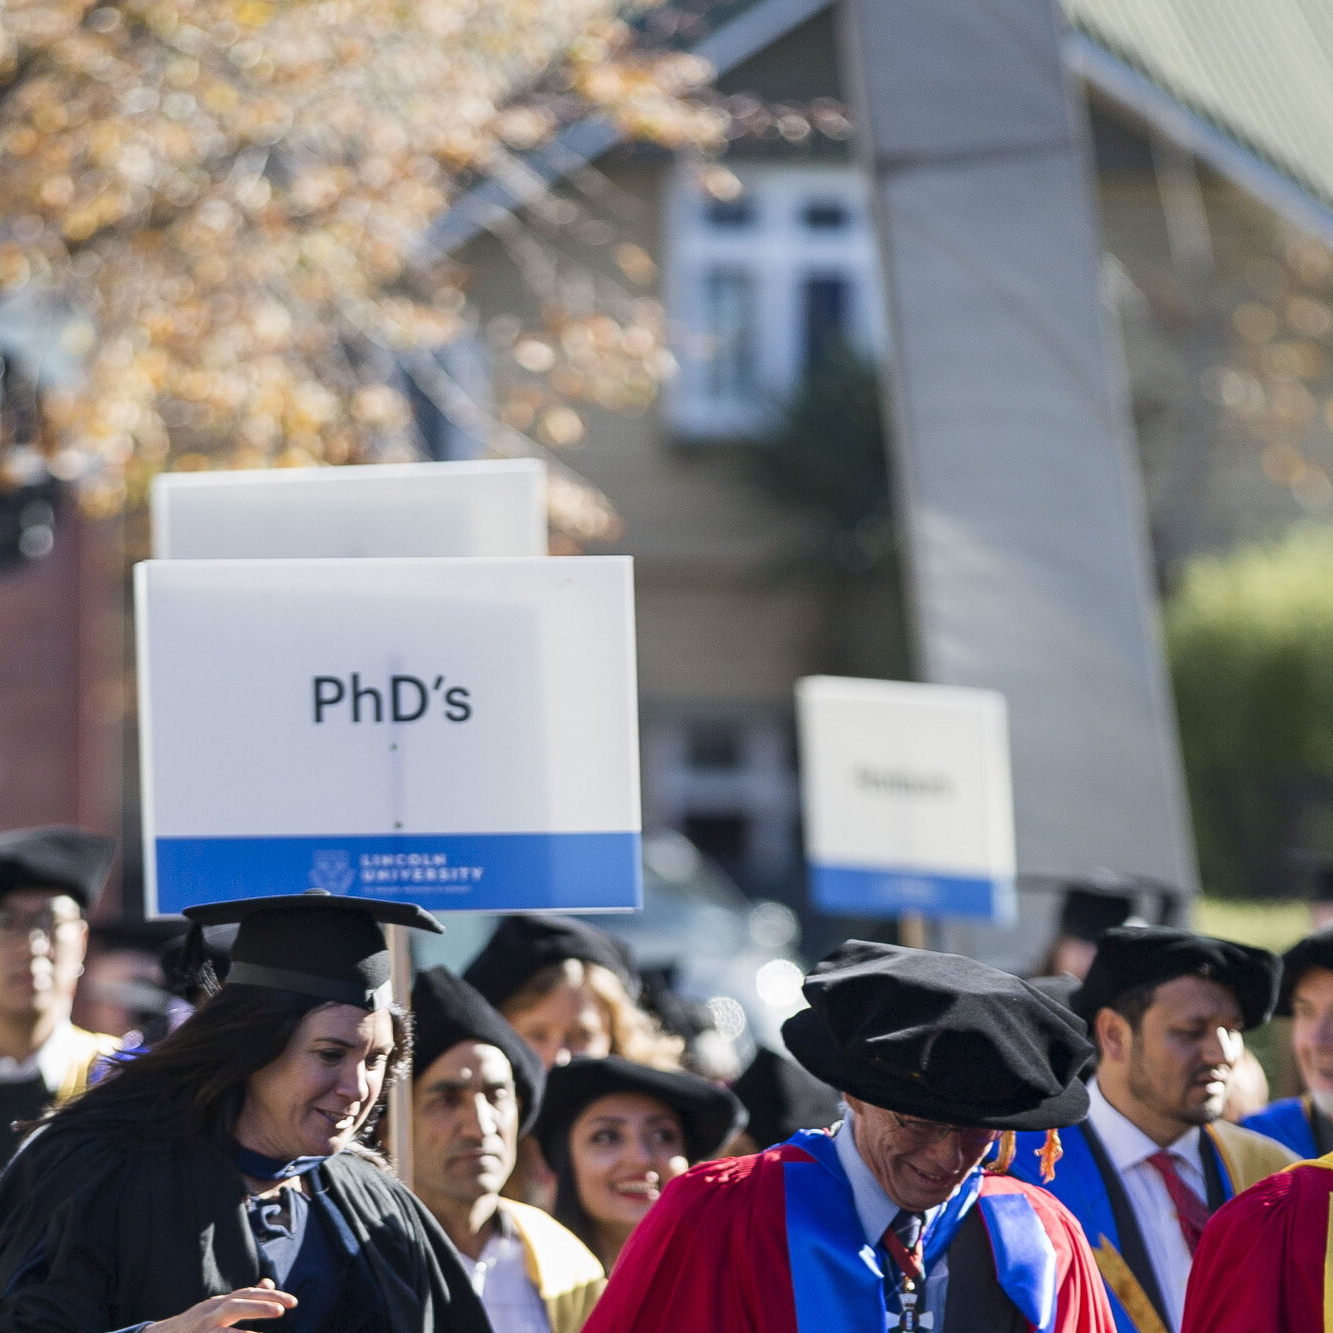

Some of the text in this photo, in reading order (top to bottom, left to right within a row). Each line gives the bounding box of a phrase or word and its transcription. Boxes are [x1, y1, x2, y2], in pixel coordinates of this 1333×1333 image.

[314, 672, 472, 723] PhD's
[360, 853, 446, 866] LINCOLN
[360, 867, 484, 882] UNIVERSITY
